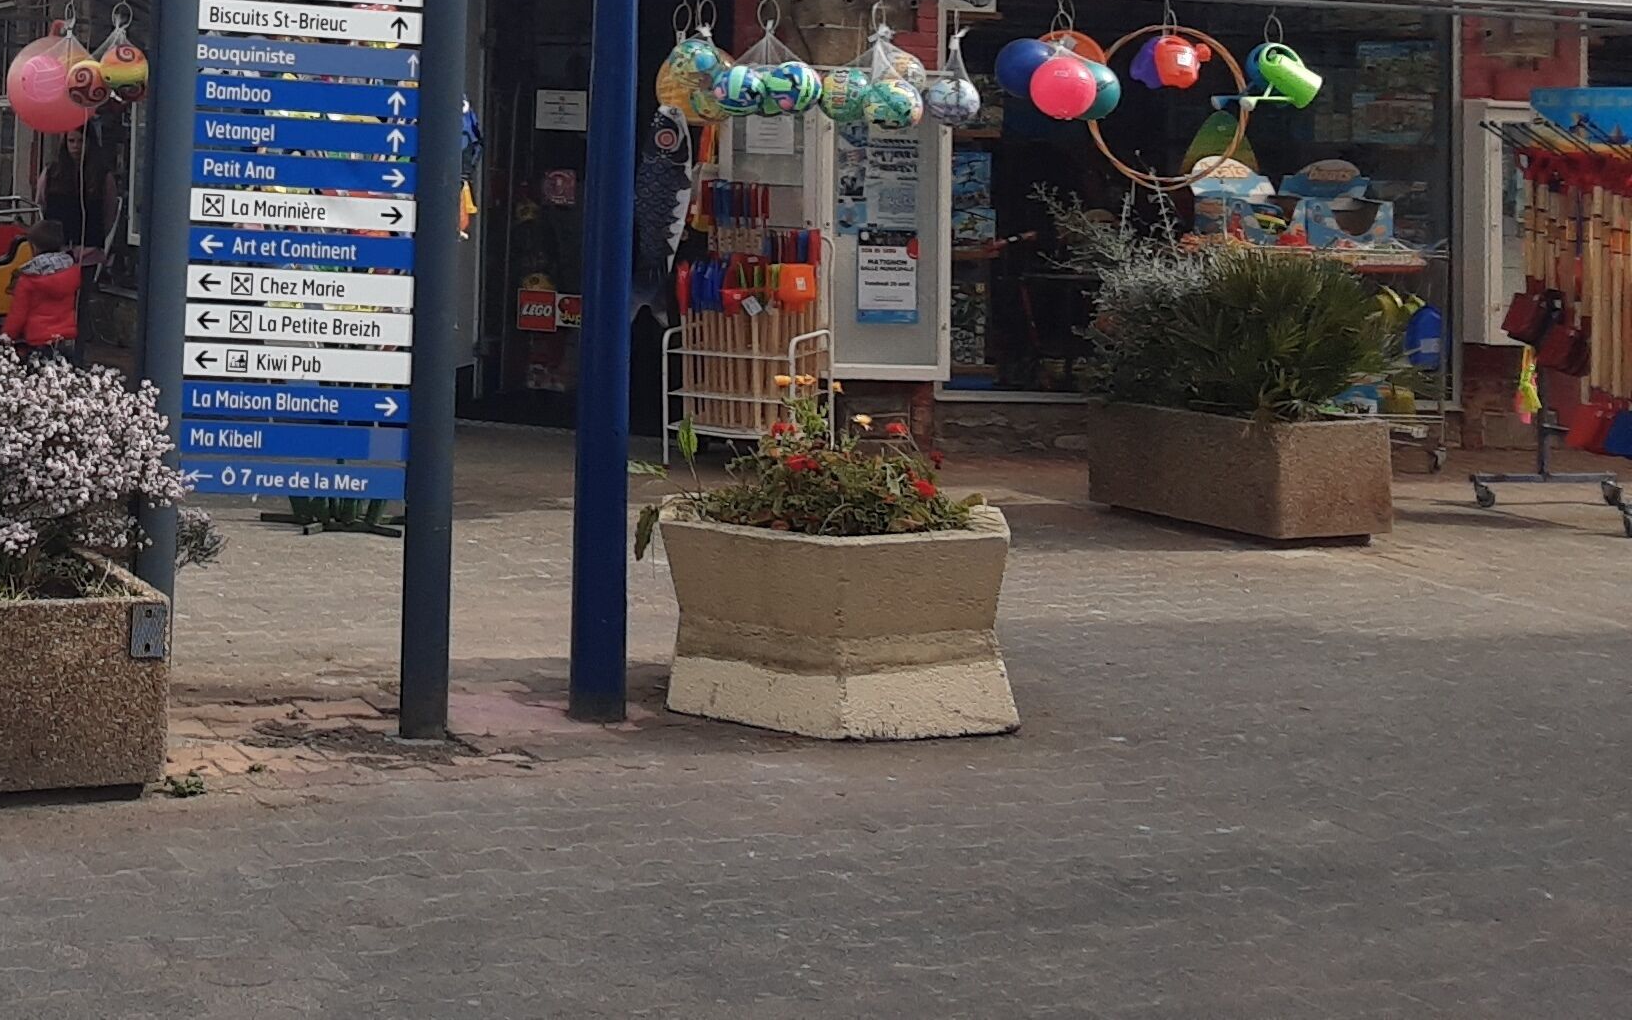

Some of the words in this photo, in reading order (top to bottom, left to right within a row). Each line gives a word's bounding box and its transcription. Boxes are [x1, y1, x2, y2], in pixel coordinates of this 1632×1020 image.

[209, 7, 269, 28] Biscuits
[273, 10, 347, 32] St-Brieuc
[196, 43, 295, 66] Bouquiniste
[205, 81, 271, 102] Bamboo
[205, 120, 275, 145] Vetangel
[203, 158, 240, 179] Petit
[244, 161, 275, 180] Ana
[231, 198, 249, 216] La
[253, 198, 326, 221] Marinière
[232, 241, 258, 257] Art
[261, 242, 276, 257] et
[280, 240, 356, 261] Continent
[260, 276, 297, 295] Chez
[302, 279, 345, 297] Marie
[521, 302, 553, 317] LEGO
[258, 314, 276, 332] La
[281, 316, 327, 335] Petite
[332, 318, 381, 338] Breizh
[256, 354, 287, 372] Kiwi
[291, 355, 321, 374] Pub
[192, 389, 212, 408] La
[215, 391, 271, 411] Maison
[275, 393, 339, 413] Blanche
[190, 428, 214, 447] Ma
[218, 430, 262, 449] Kibell
[241, 468, 252, 486] 7
[255, 473, 284, 489] rue
[288, 470, 310, 489] de
[314, 471, 330, 490] la
[334, 475, 368, 492] Mer
